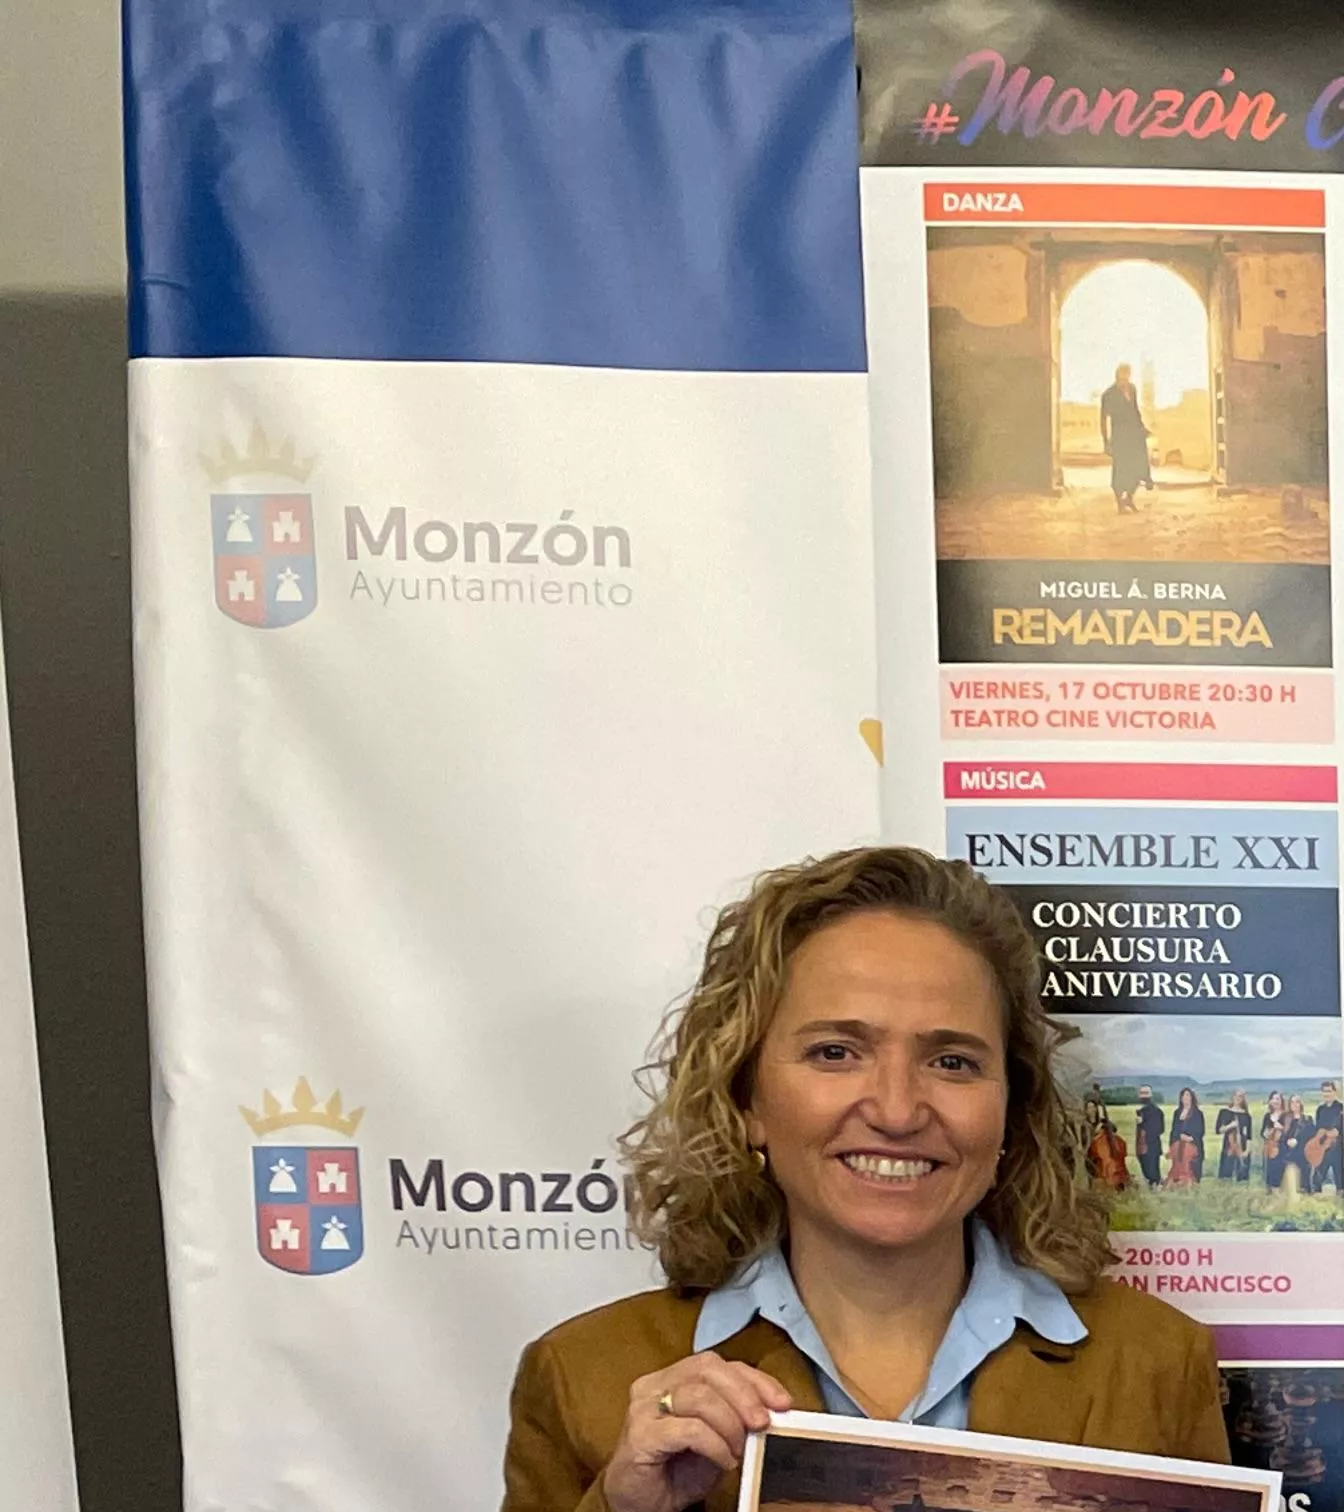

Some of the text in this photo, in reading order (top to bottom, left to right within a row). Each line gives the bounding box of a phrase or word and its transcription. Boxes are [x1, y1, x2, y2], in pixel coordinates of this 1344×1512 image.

[944, 194, 1023, 211] DANZA
[345, 506, 630, 572] Monzón
[349, 571, 632, 608] Ayuntamiento
[991, 608, 1273, 650] REMATADERA
[950, 682, 1295, 702] VIERNES, 17 OCTUBRE 20:30 H
[951, 710, 1215, 728] TEATRO CINE VICTORIA
[962, 771, 1045, 789] MÚSICA
[966, 834, 1318, 871] ENSEMBLE XXI
[1032, 902, 1242, 930] CONCIERTO
[1045, 936, 1230, 965] CLAUSURA
[1042, 970, 1282, 1000] ANIVERSARIO
[388, 1158, 633, 1213] Monzó
